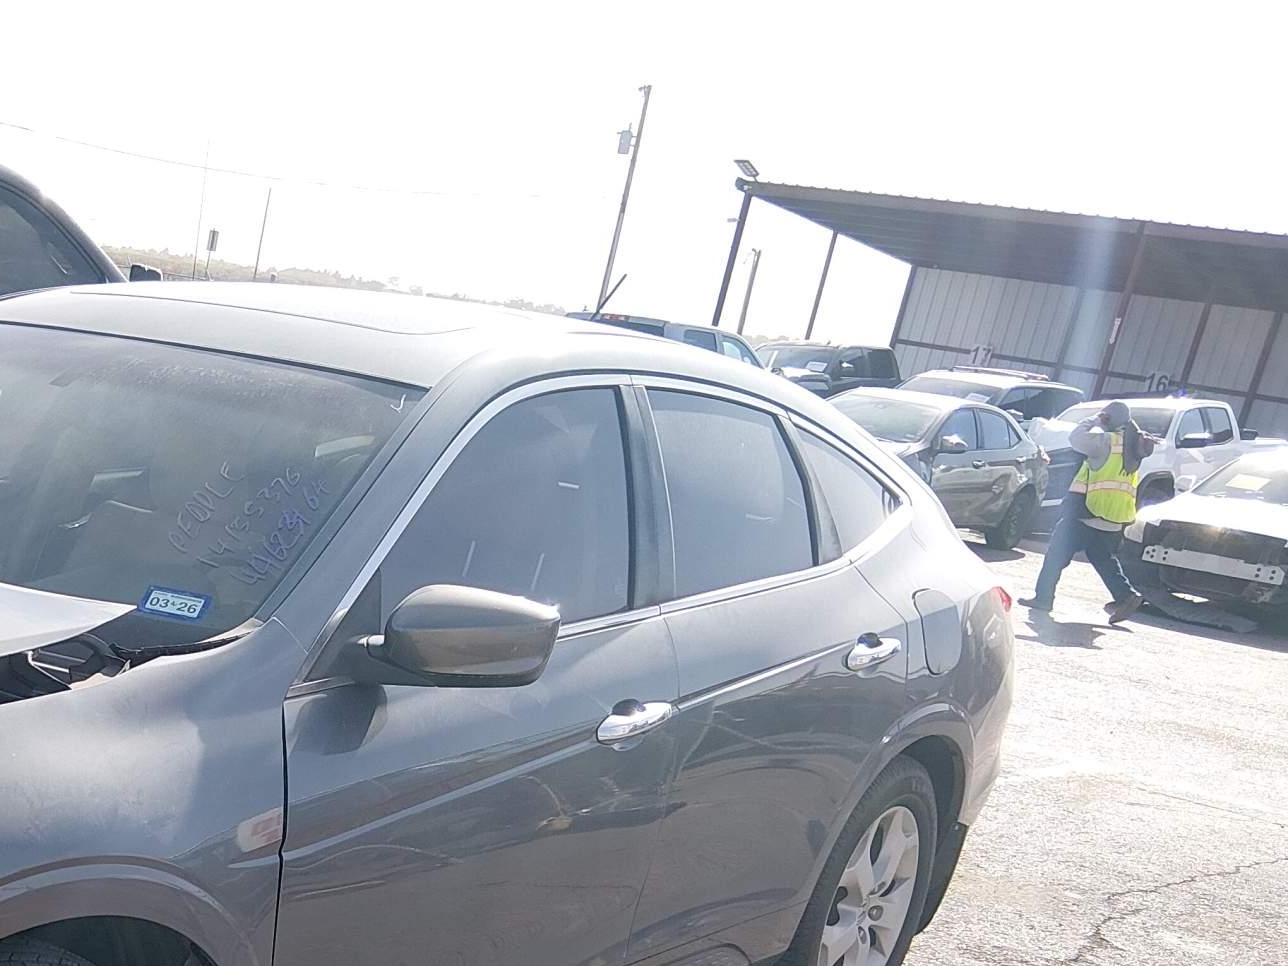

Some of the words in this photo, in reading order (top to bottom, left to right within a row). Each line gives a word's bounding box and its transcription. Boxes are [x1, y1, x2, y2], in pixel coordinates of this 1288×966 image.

[1143, 372, 1169, 393] 16
[149, 596, 170, 608] 03
[176, 601, 198, 614] 26
